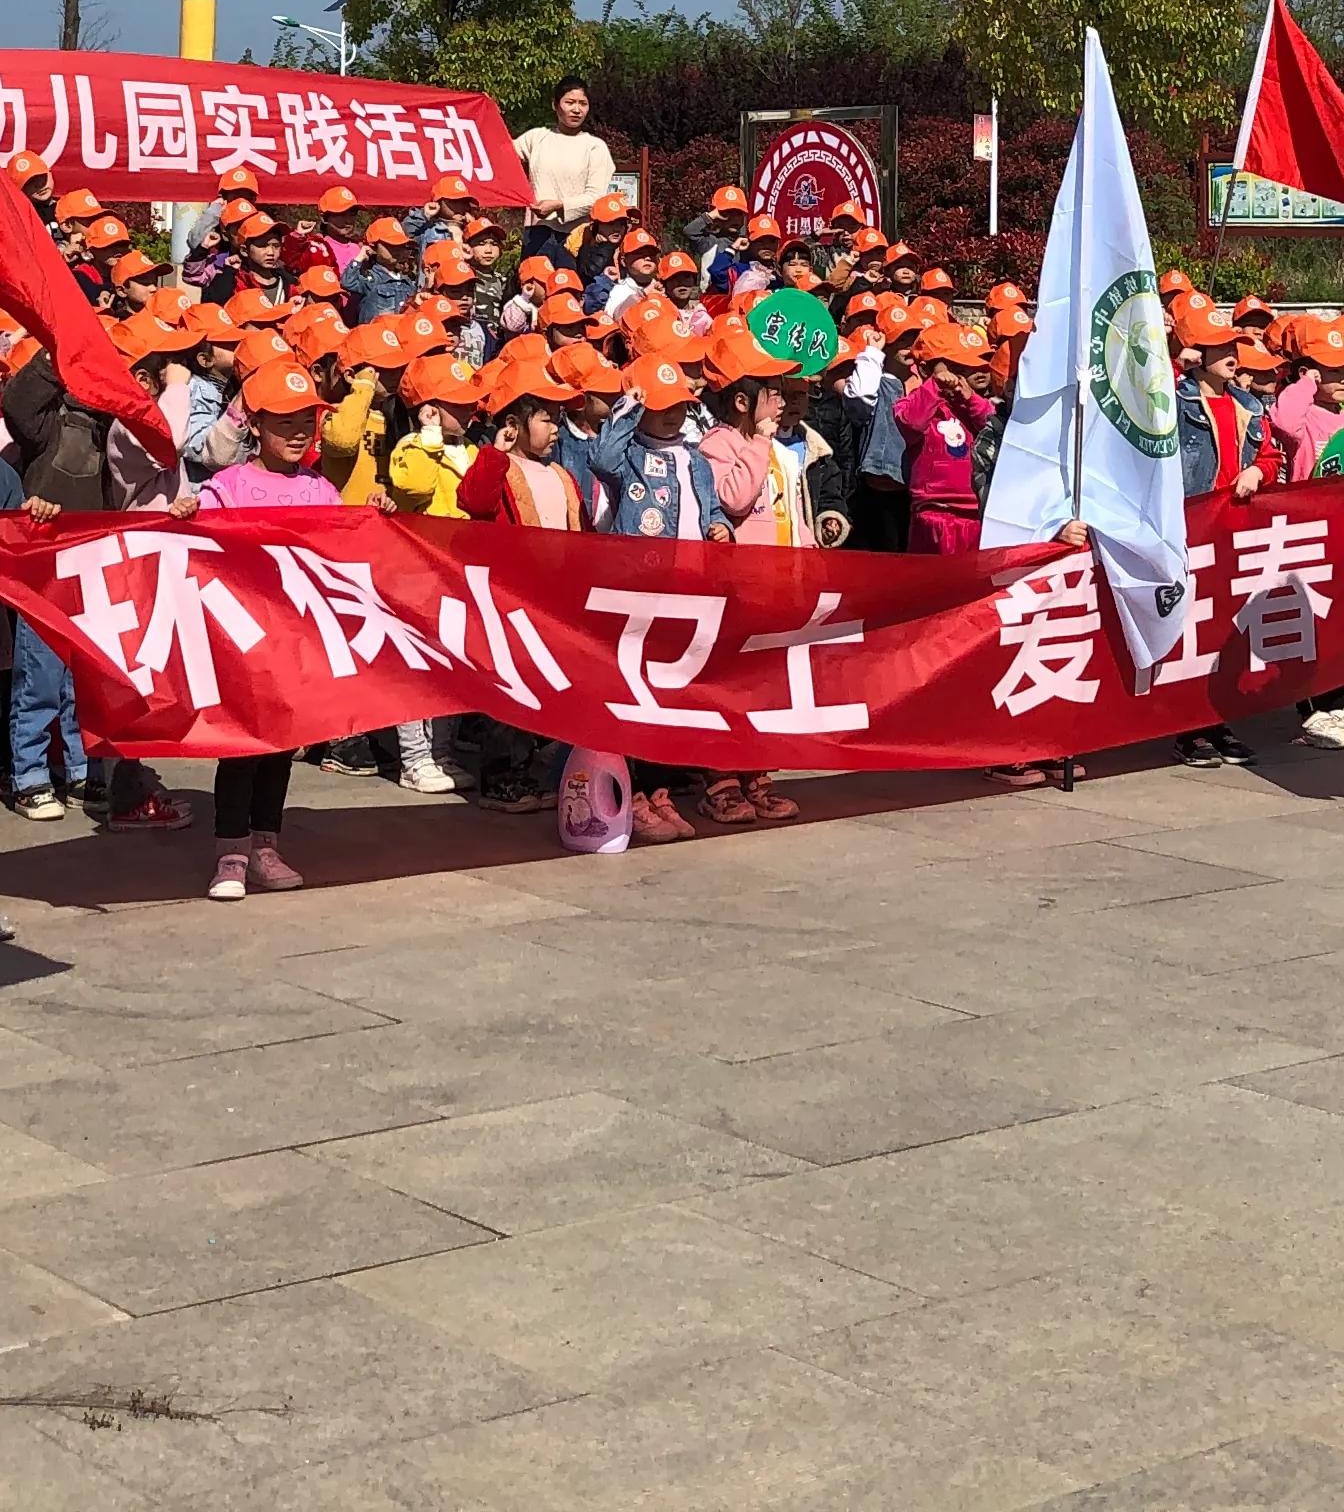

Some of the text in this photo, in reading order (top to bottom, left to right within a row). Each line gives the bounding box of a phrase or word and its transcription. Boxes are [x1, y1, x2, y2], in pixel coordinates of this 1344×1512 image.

[786, 216, 832, 236] 扫黑除
[761, 310, 829, 359] 宣传队
[57, 530, 869, 734] 环保小卫士
